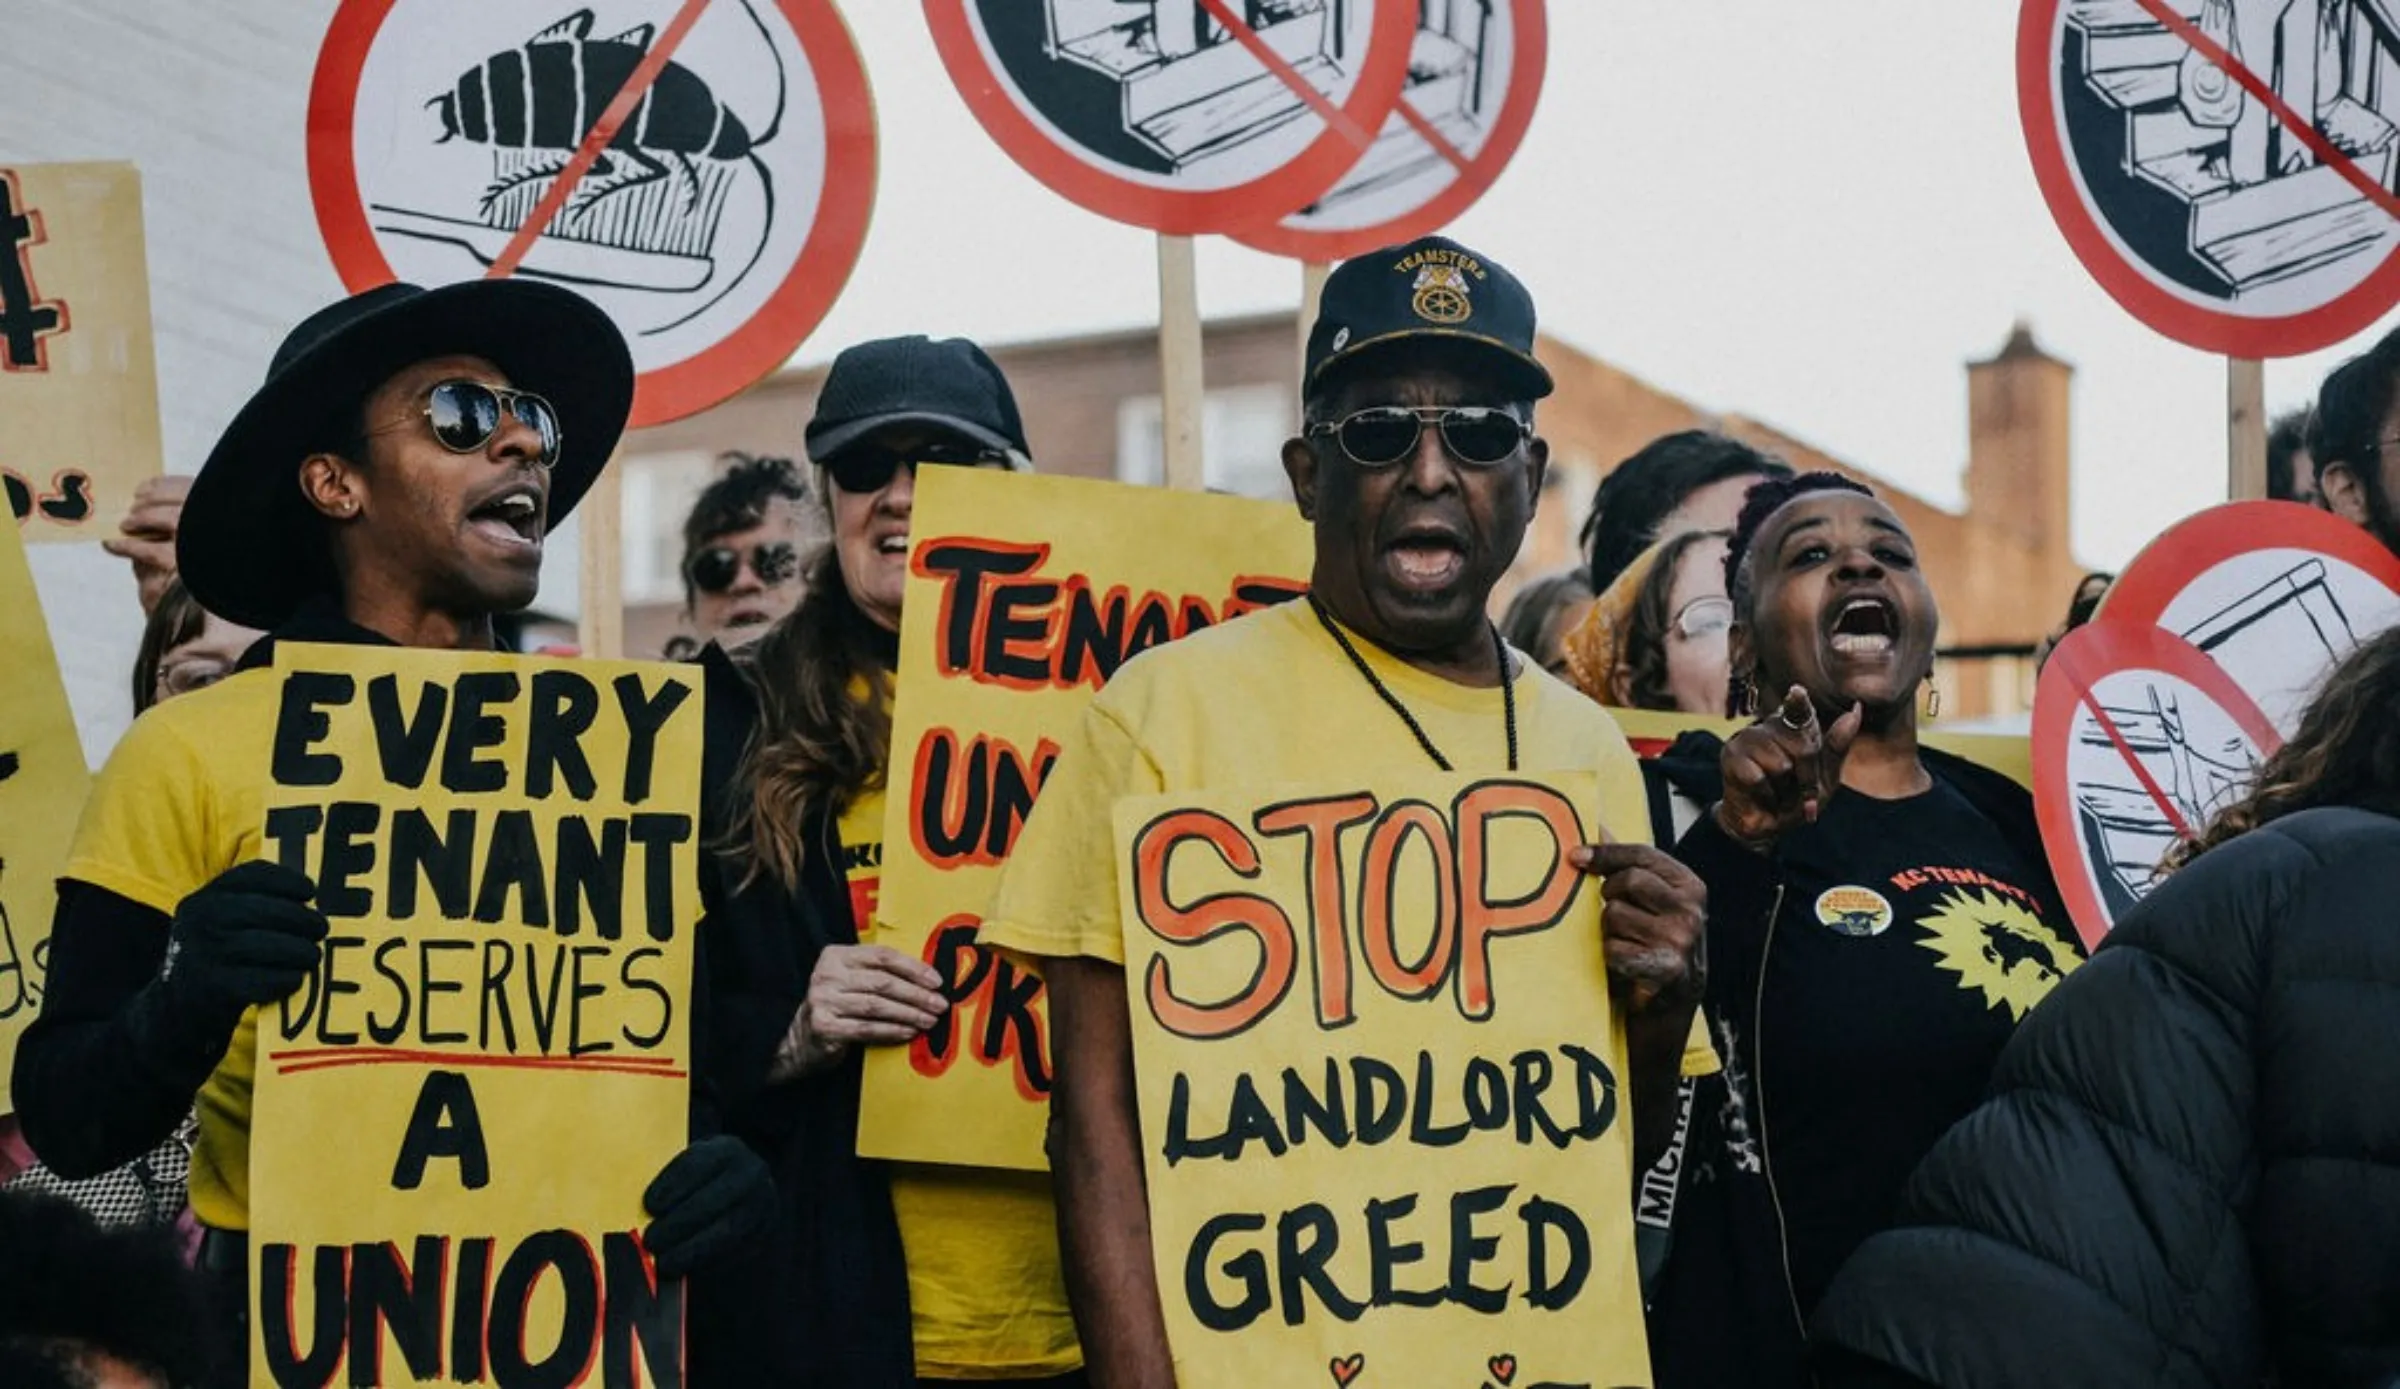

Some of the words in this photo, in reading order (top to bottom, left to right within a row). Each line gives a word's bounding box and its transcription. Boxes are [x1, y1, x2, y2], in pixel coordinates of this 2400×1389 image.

[1393, 248, 1486, 281] TEAMSTERS
[271, 669, 692, 803] EVERY
[265, 801, 692, 941] TENANT
[1132, 779, 1586, 1041] STOP
[279, 936, 671, 1059] DESERVES
[391, 1070, 490, 1190] A
[1163, 1043, 1617, 1167] LANDLORD
[260, 1228, 689, 1389] UNION
[1185, 1183, 1592, 1331] GREED
